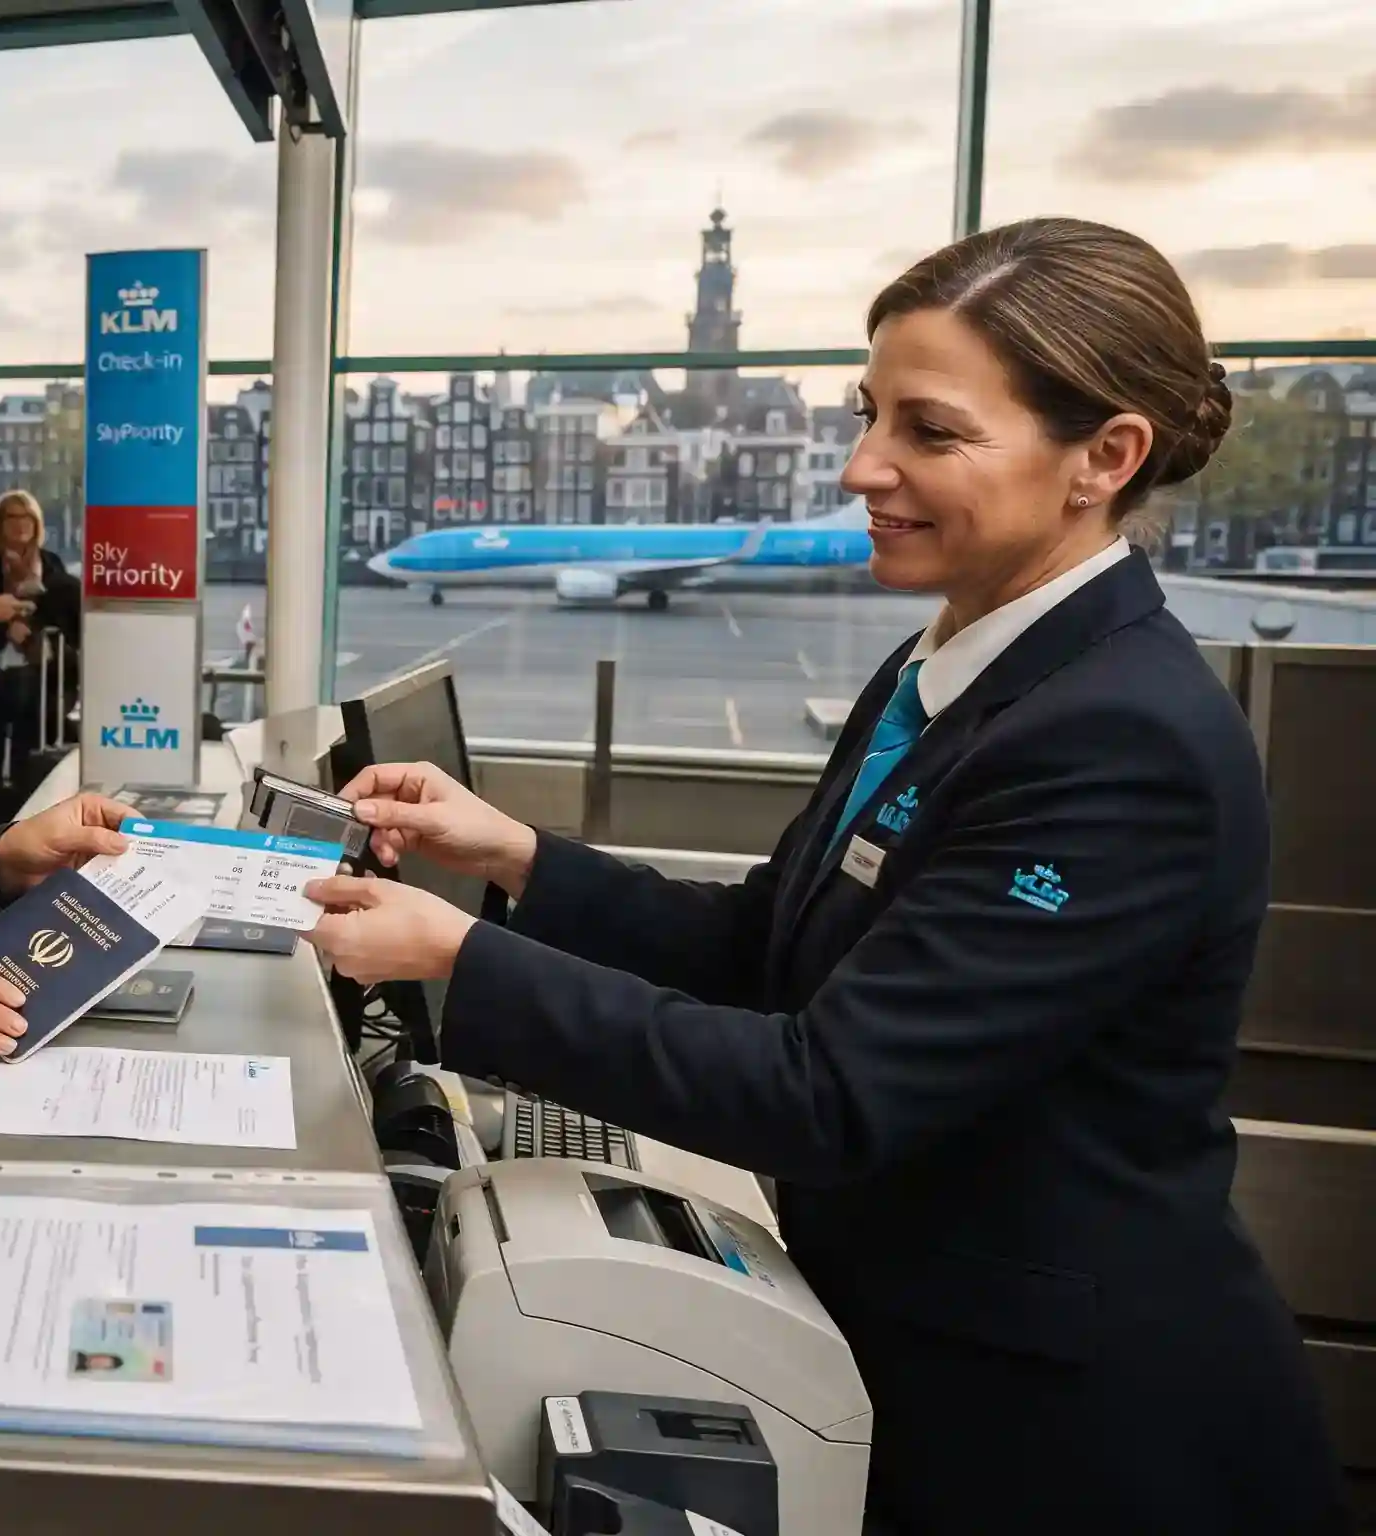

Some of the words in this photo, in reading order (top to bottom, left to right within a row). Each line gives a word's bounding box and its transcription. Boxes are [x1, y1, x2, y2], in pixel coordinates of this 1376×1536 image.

[100, 308, 178, 334] KLM
[98, 350, 183, 372] Check-in
[92, 541, 128, 567] Sky
[92, 562, 183, 591] Priority
[100, 726, 180, 750] KLM
